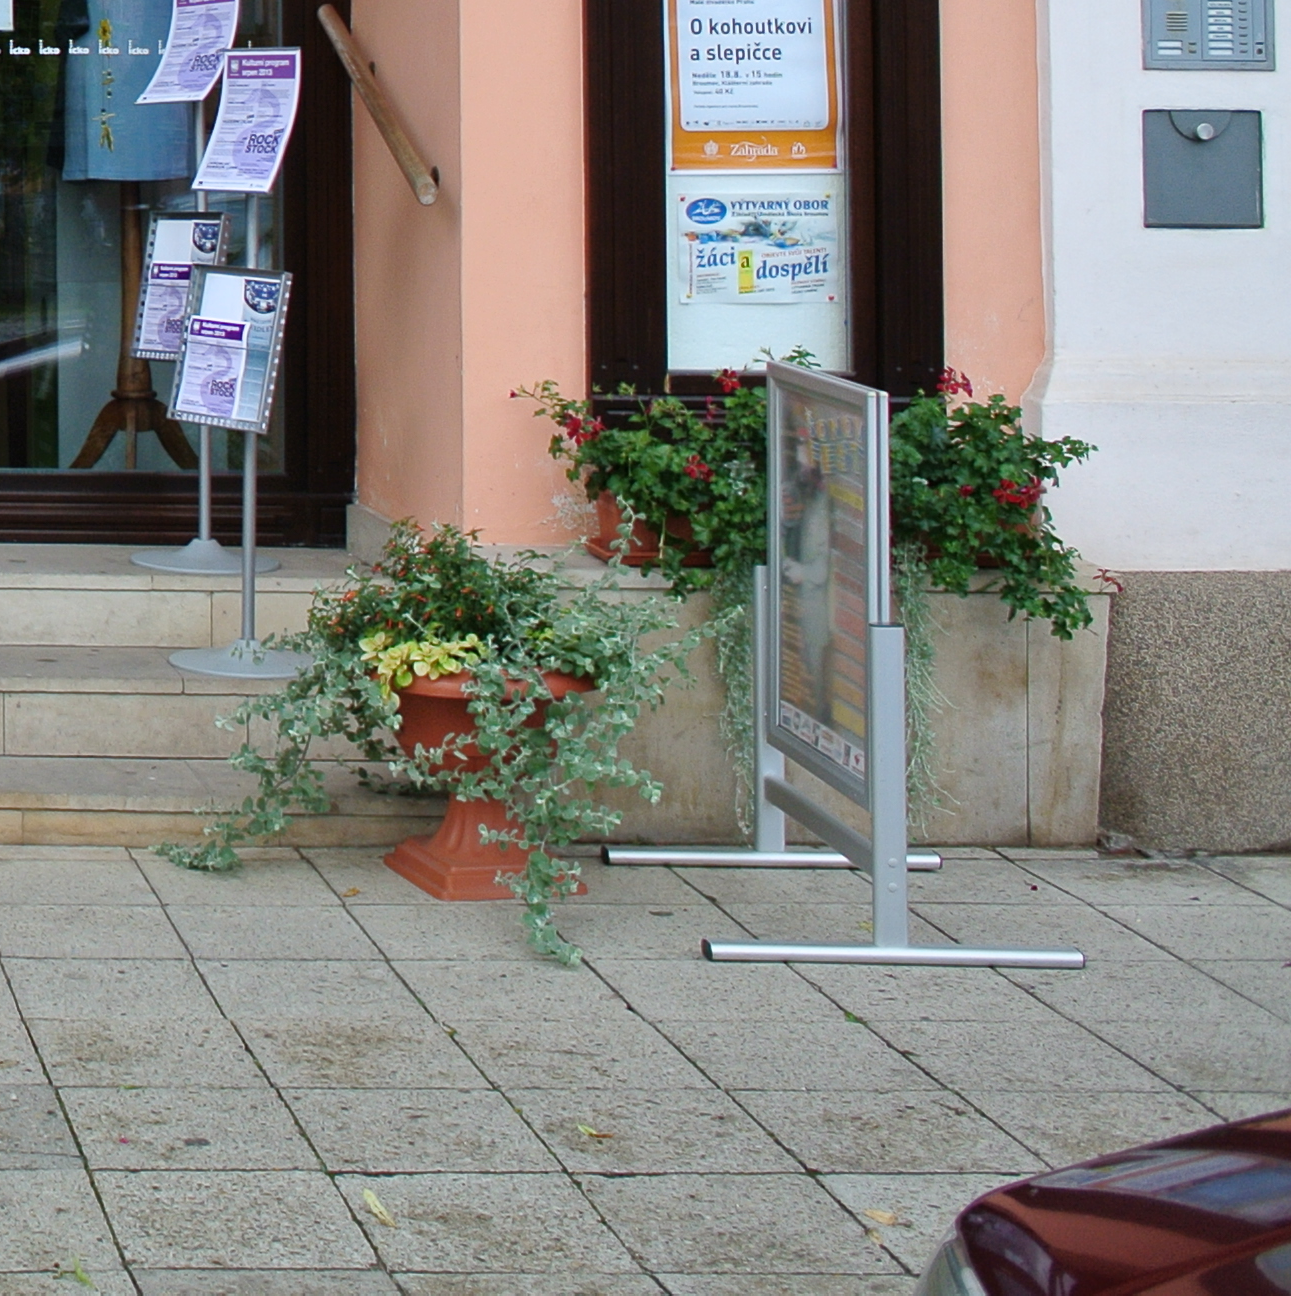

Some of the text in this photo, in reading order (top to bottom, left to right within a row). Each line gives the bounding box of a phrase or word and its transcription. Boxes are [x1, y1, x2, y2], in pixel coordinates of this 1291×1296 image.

[690, 17, 813, 35] O kohoutkovi
[193, 53, 220, 64] ROCK
[690, 42, 782, 65] a slepičce
[188, 63, 218, 73] STOCK
[720, 70, 742, 79] 18.8.
[751, 70, 762, 78] 15
[247, 132, 282, 145] ROCK
[244, 144, 278, 154] STOCK
[730, 141, 779, 162] Zahrada
[730, 197, 829, 211] VÝTVARNÝ OBOR
[696, 246, 751, 269] žáci a
[756, 253, 829, 280] dospělí
